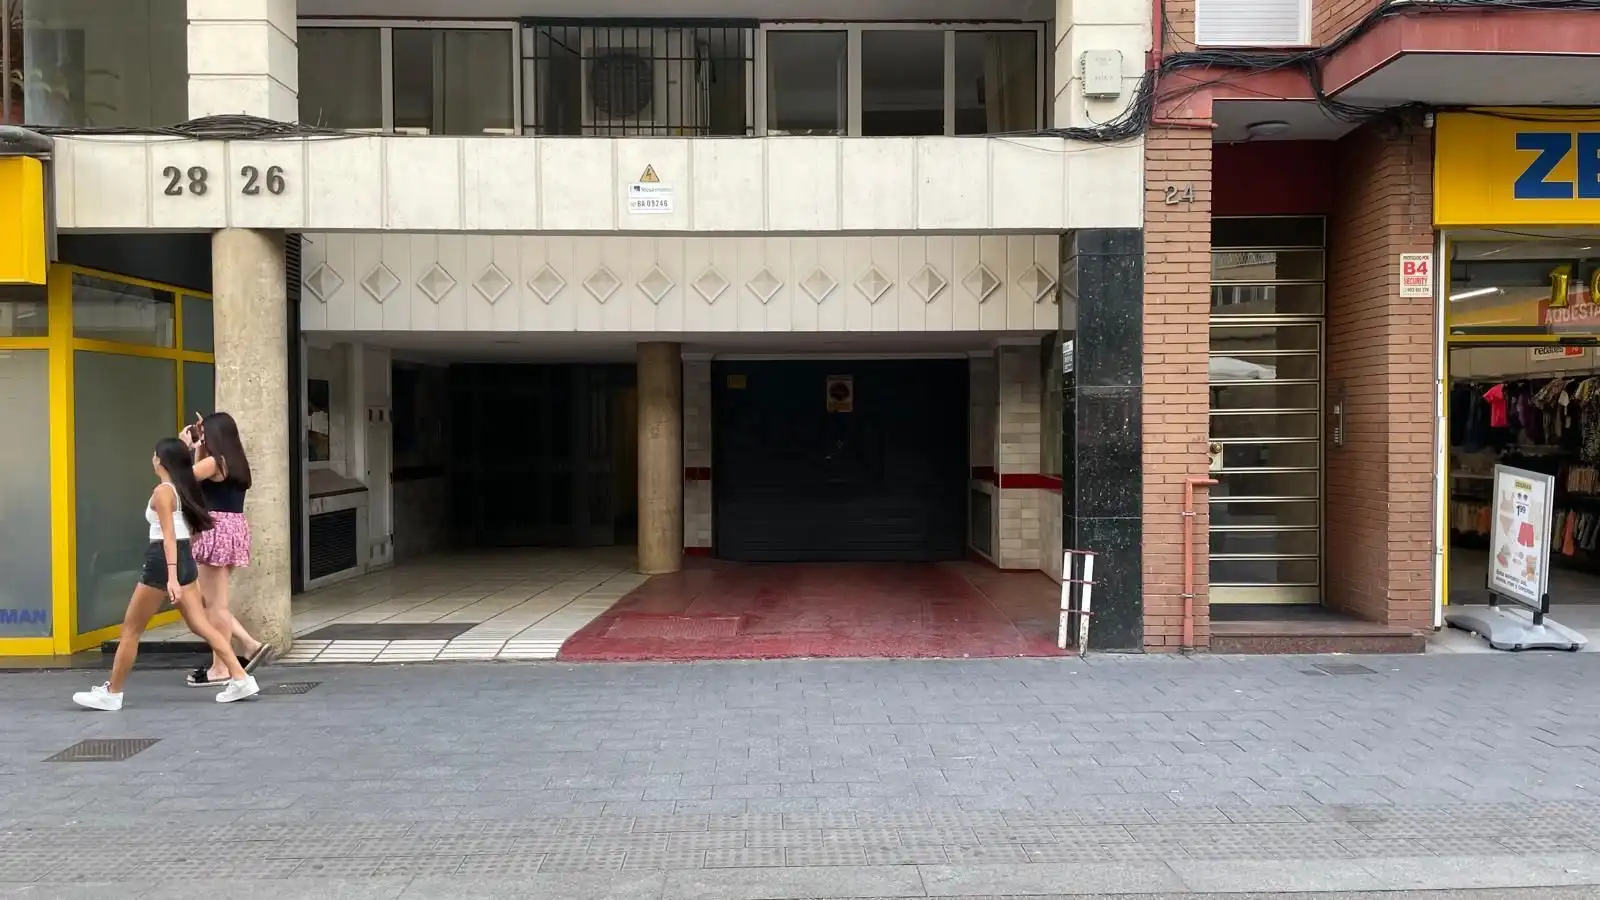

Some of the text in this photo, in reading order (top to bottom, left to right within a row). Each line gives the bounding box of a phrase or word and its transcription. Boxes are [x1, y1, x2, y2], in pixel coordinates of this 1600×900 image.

[162, 165, 208, 196] 28
[240, 165, 285, 195] 26
[1164, 183, 1195, 205] 24
[1403, 261, 1428, 275] B4
[1403, 277, 1428, 285] SECURITY
[0, 608, 46, 625] MAN
